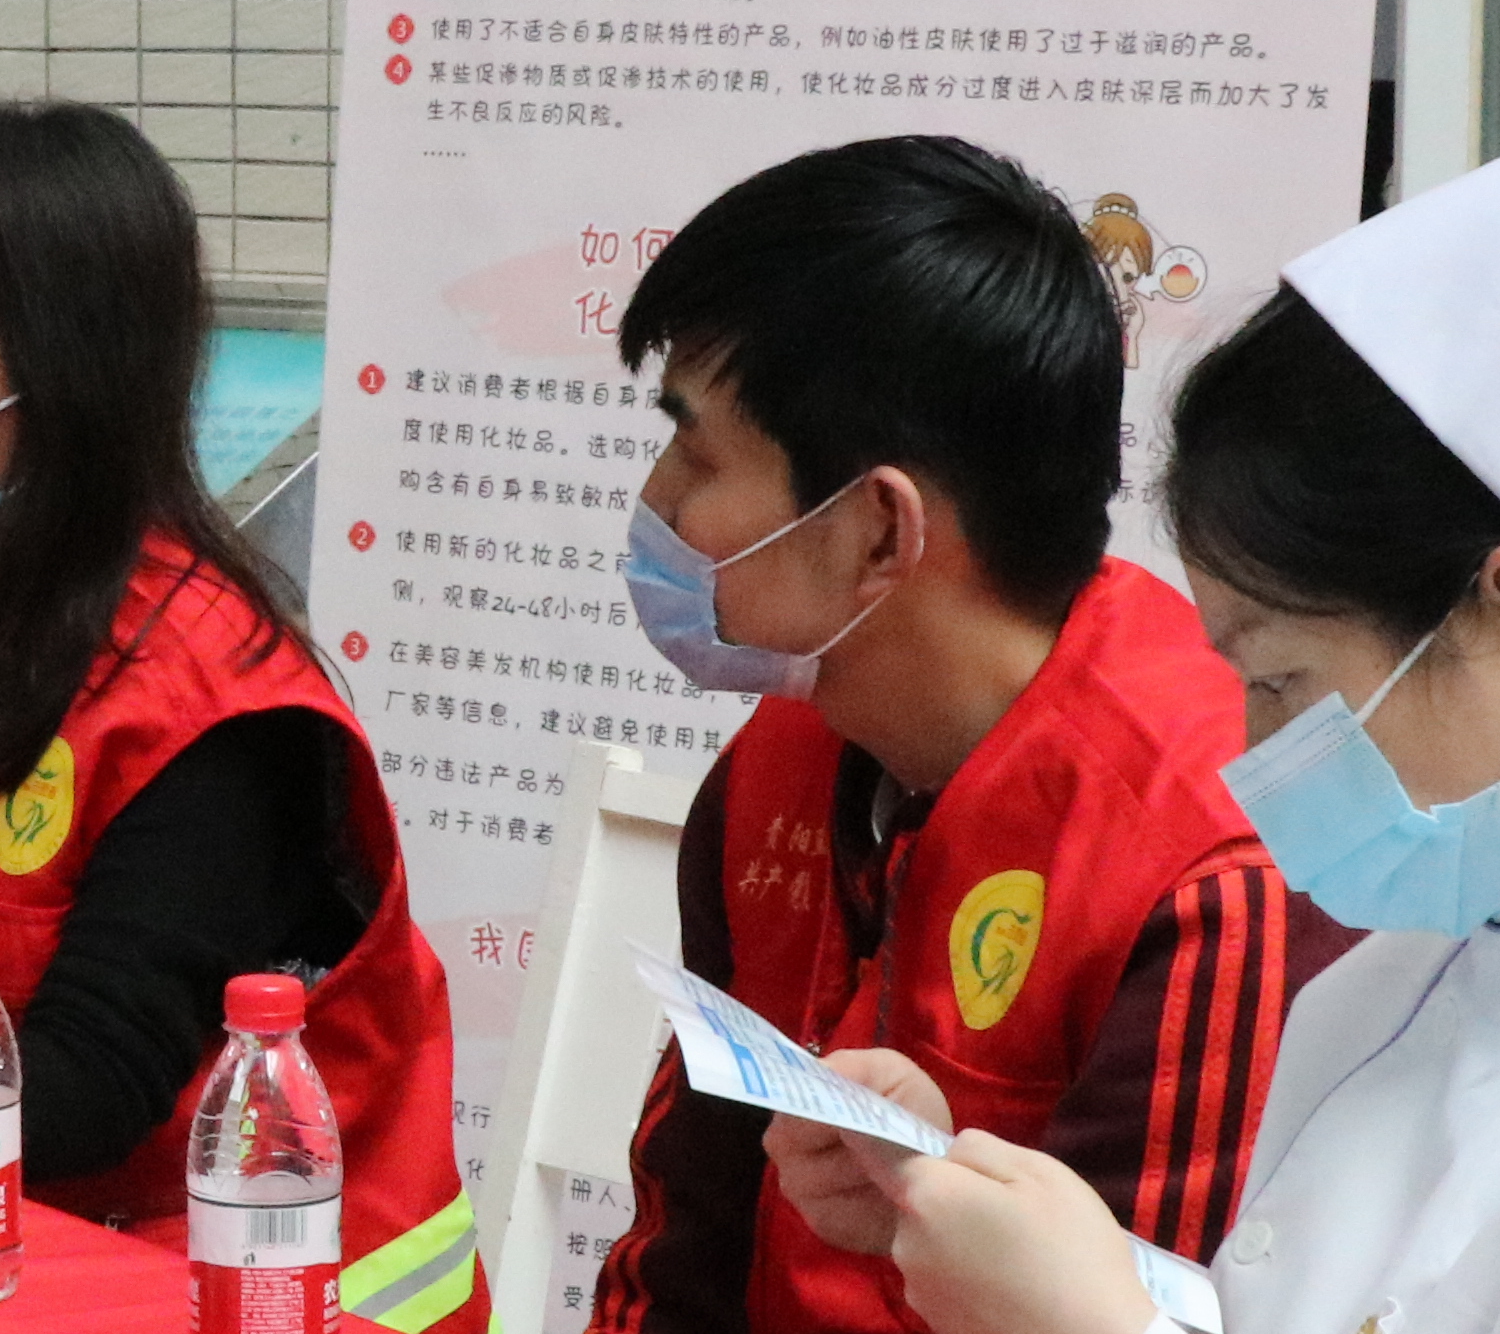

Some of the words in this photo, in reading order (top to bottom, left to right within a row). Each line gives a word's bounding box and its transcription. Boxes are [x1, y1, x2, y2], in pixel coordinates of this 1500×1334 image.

[427, 100, 624, 130] 生不良反应的风险。
[581, 223, 674, 270] 如何
[575, 290, 618, 334] 化
[398, 469, 630, 512] 购含有自身易致敏成
[384, 689, 722, 755] 厂家等信息，建议避免使用其
[390, 804, 555, 848] 。对于消费者
[563, 1285, 597, 1312] 受
